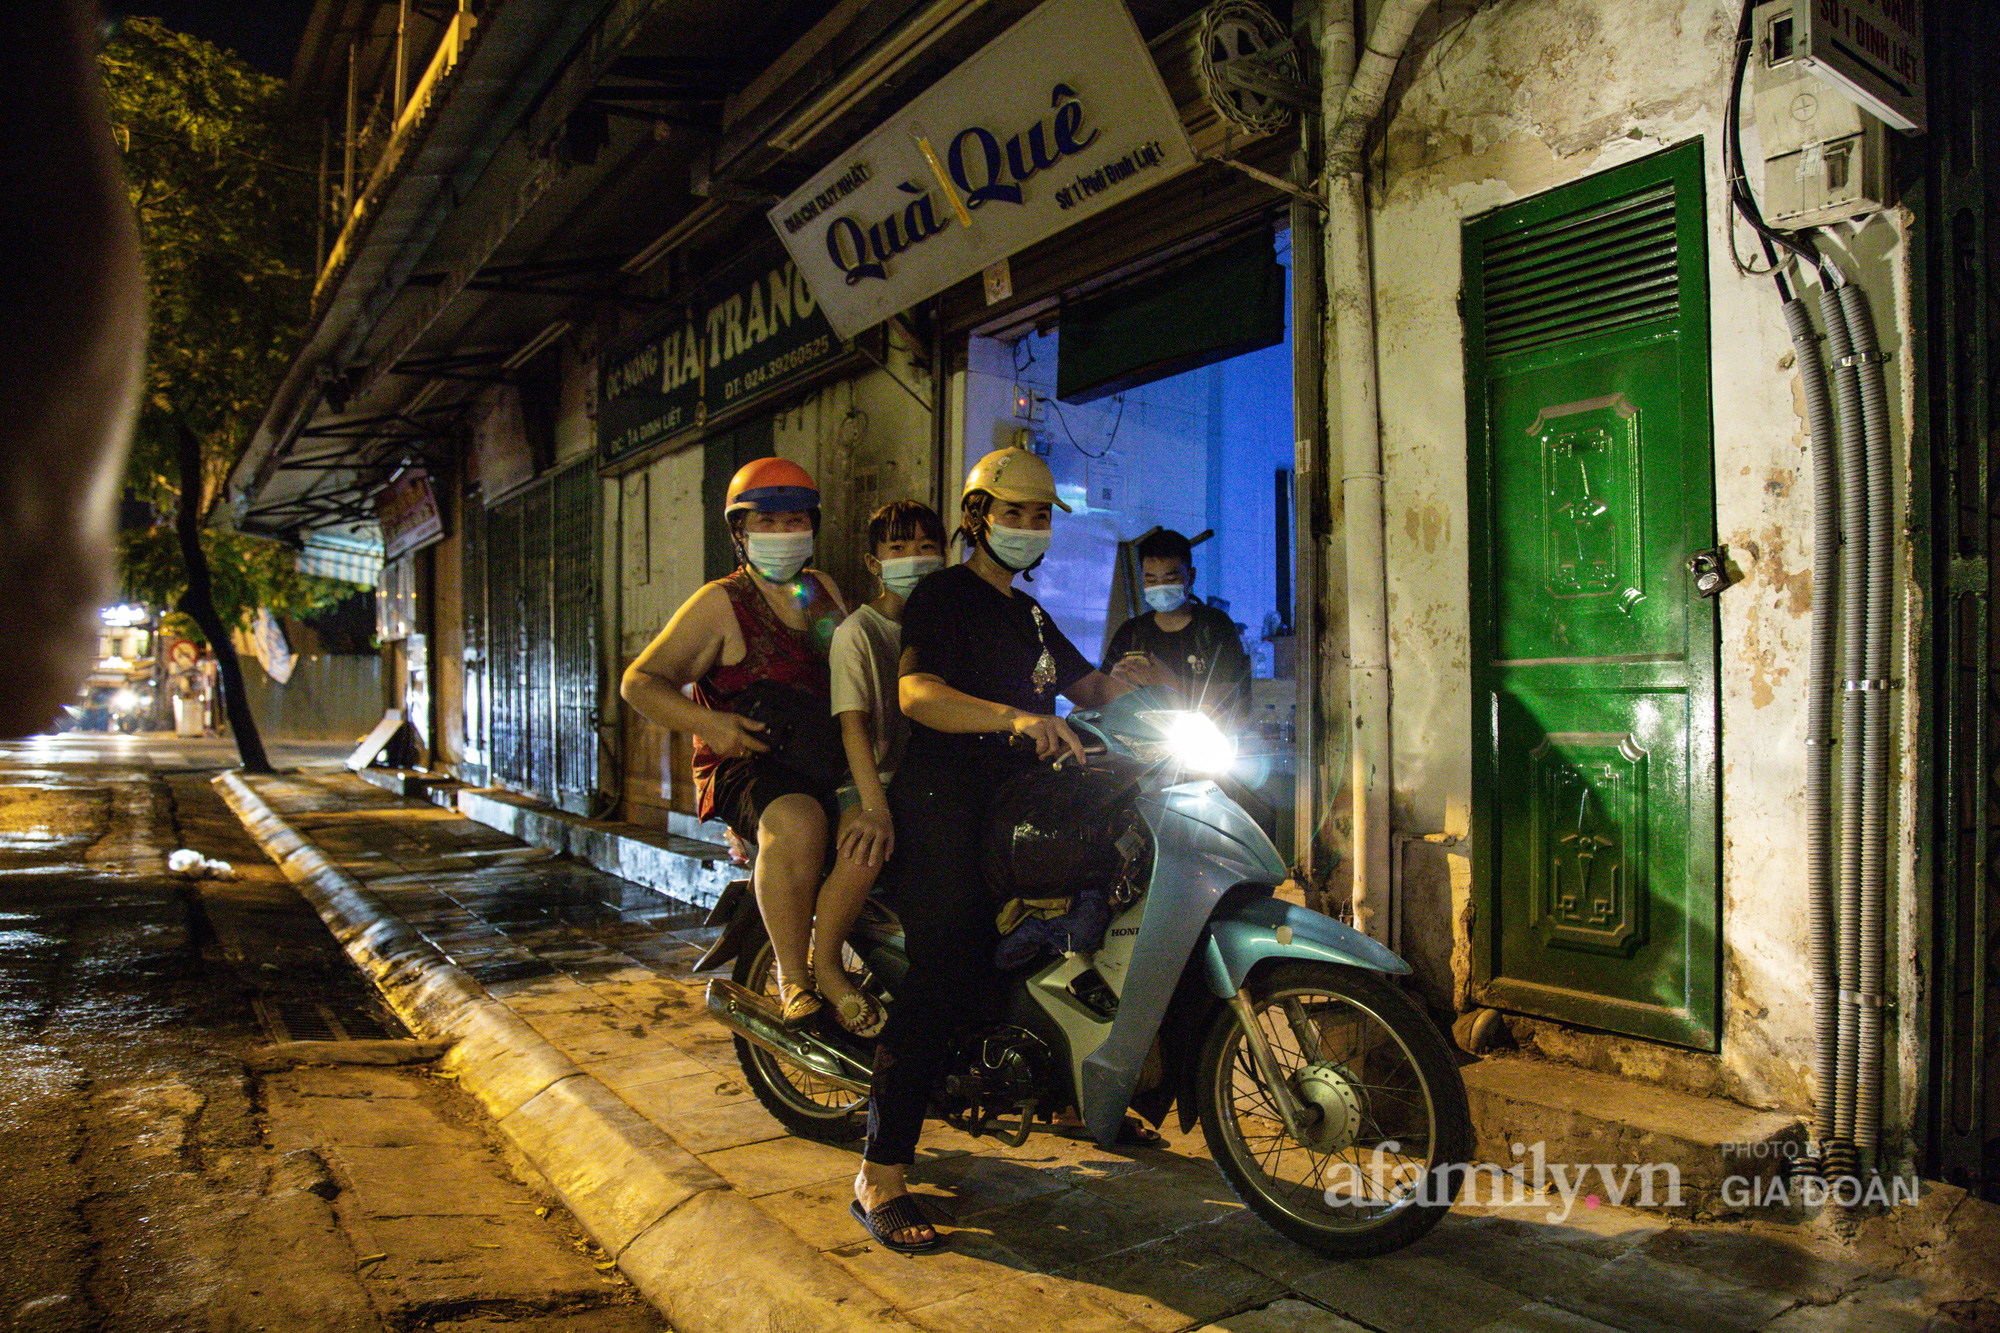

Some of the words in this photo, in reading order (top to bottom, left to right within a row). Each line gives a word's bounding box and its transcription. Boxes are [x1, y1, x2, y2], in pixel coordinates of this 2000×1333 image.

[1843, 7, 1850, 37] 1
[825, 181, 950, 286] Quà
[947, 83, 1100, 210] Quê
